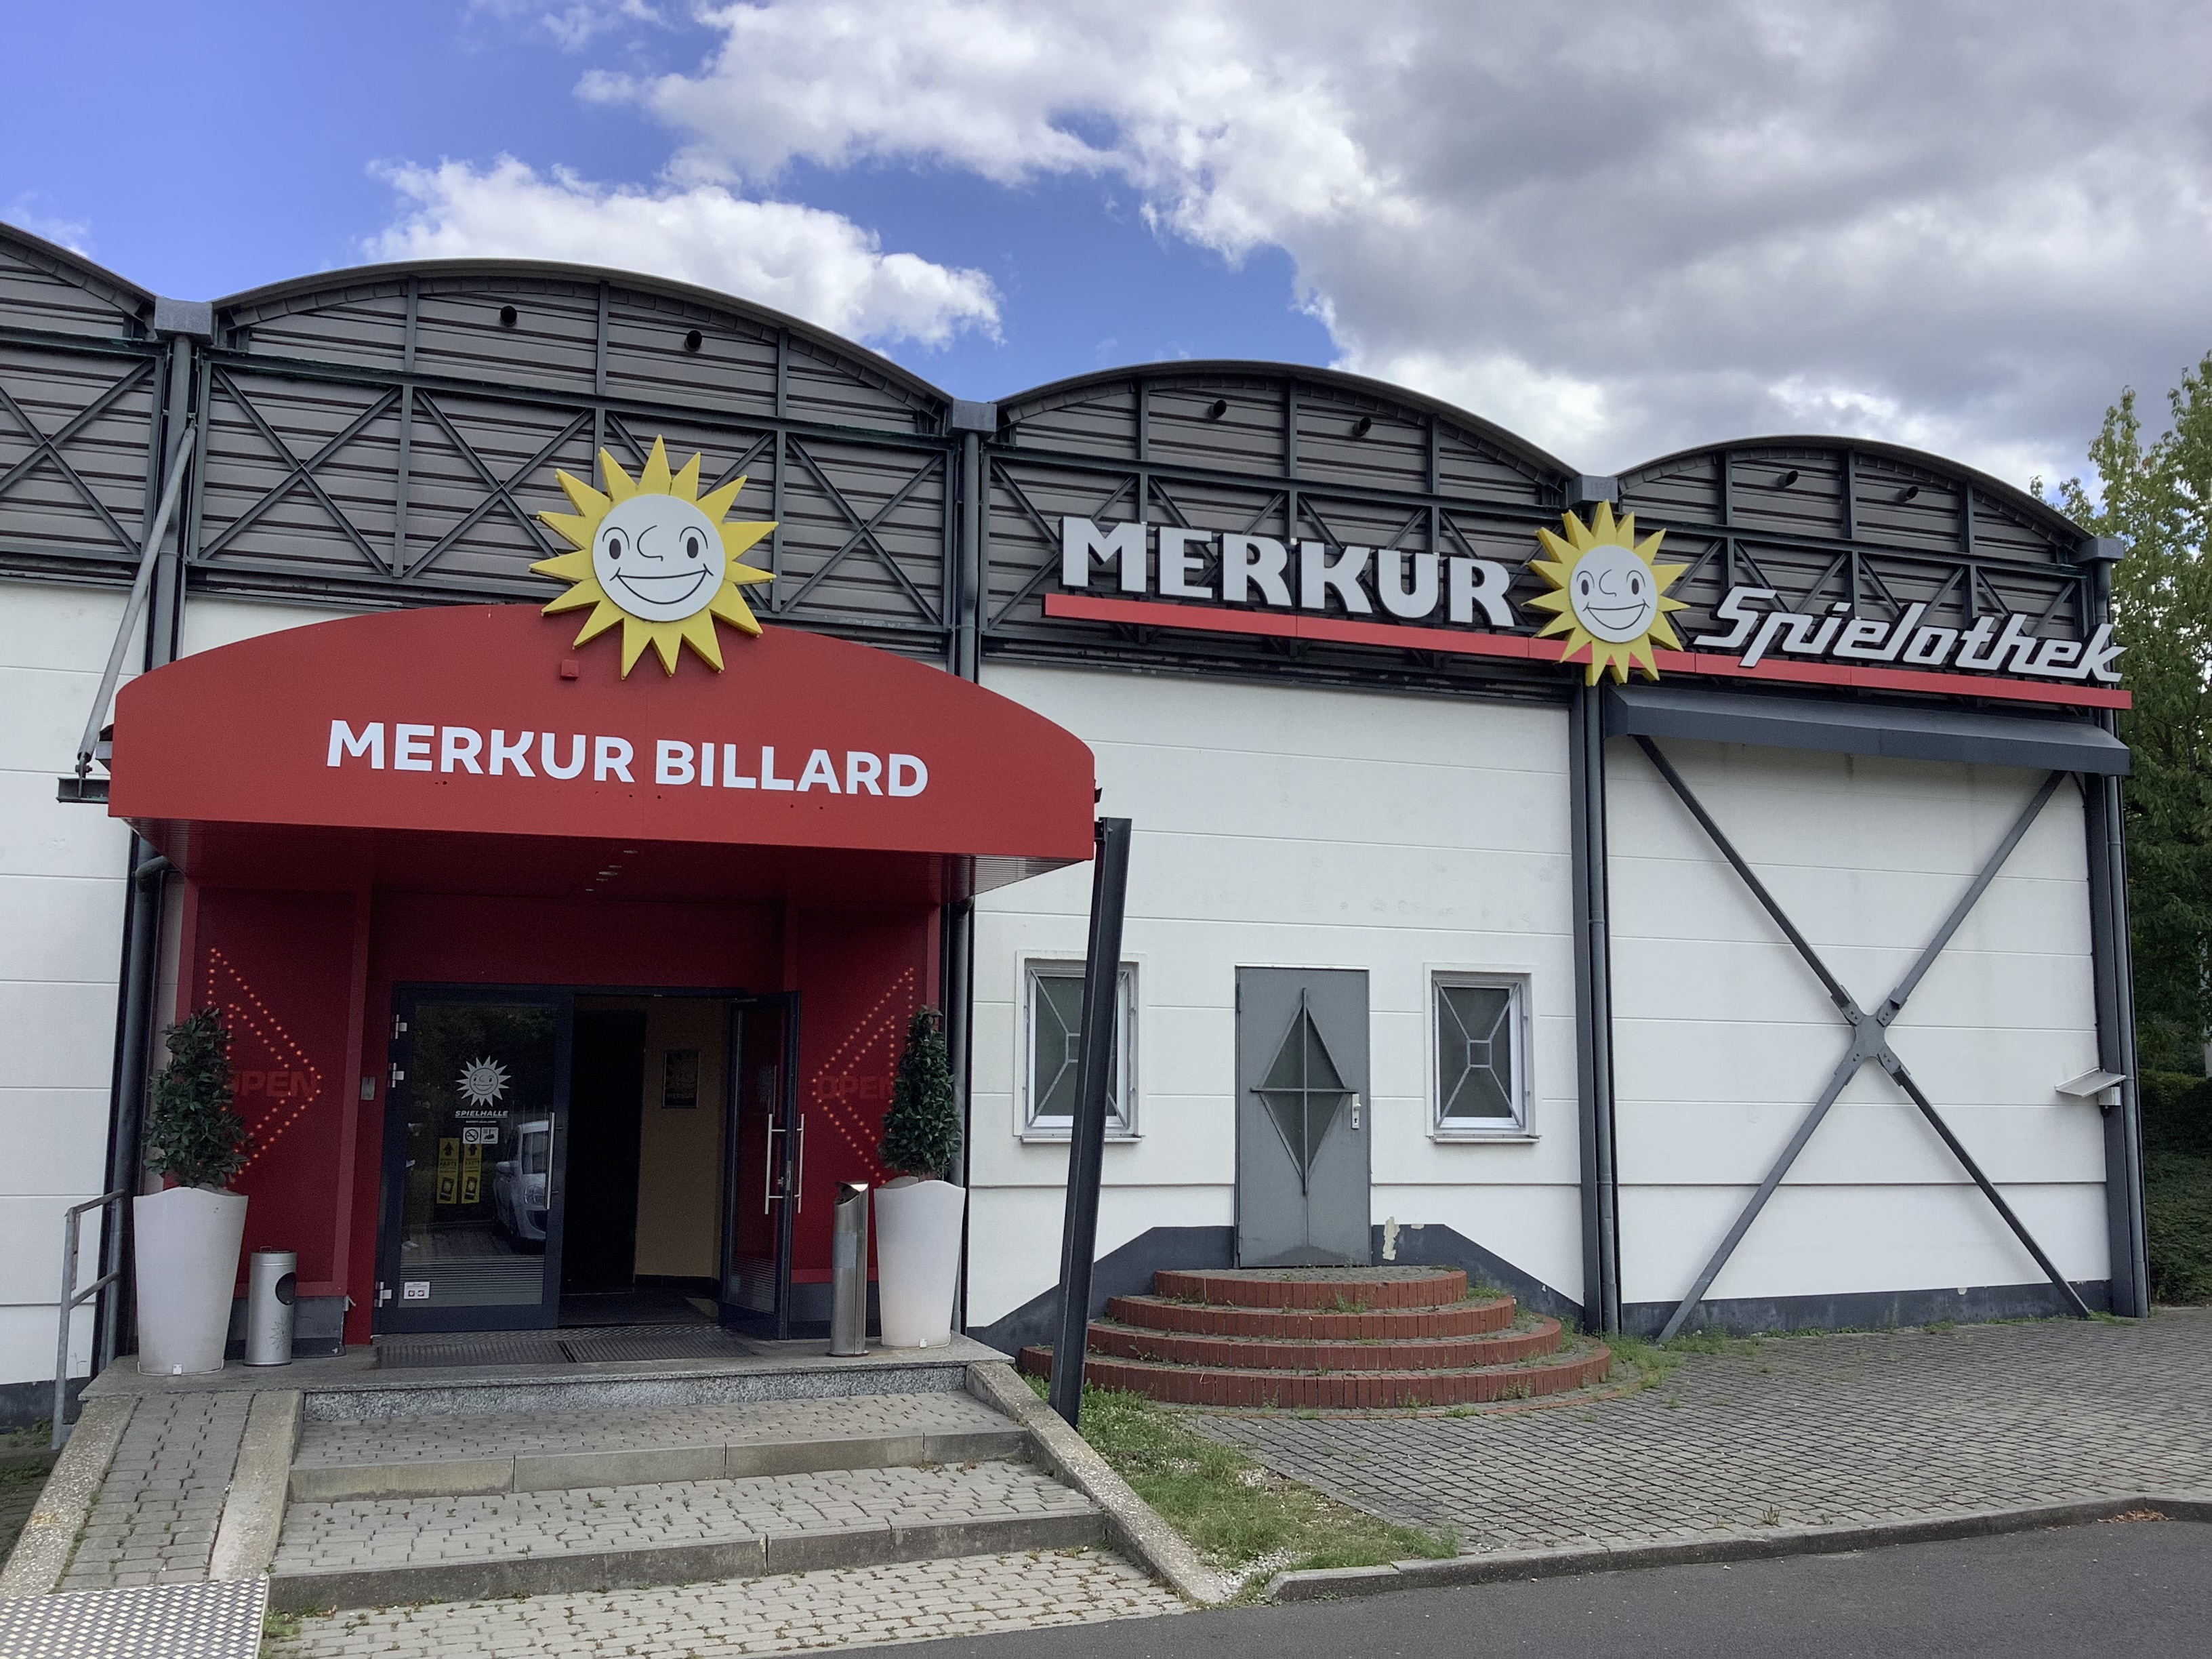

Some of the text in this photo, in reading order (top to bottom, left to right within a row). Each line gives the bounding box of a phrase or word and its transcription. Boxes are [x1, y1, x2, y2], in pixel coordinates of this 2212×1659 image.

[1060, 516, 1516, 628] MERKUR
[1693, 586, 2129, 682] Spielothek
[327, 720, 928, 797] MERKUR BILLARD
